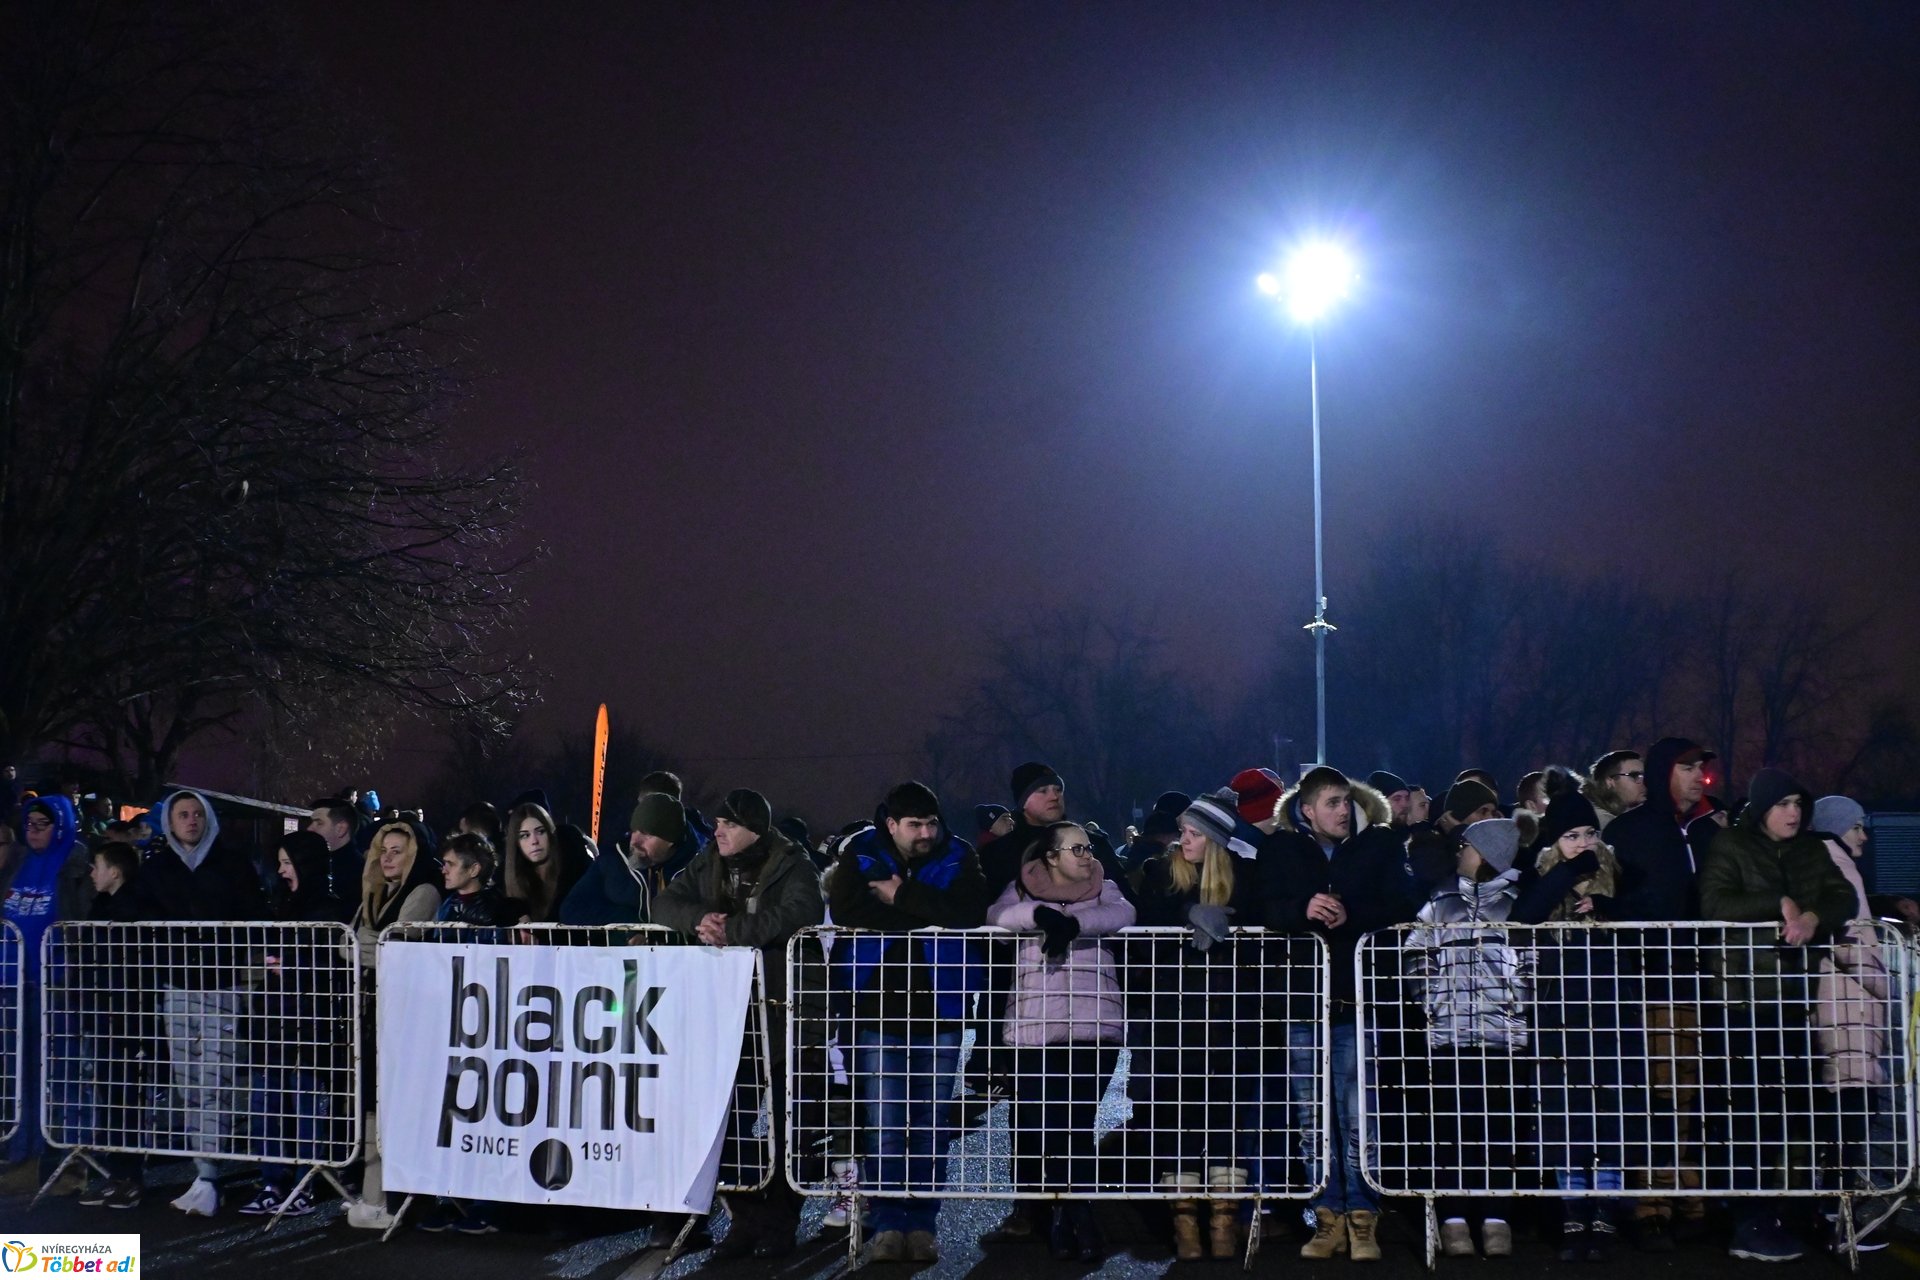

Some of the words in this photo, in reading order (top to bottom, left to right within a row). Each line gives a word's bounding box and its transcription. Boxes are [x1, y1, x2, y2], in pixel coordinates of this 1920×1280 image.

[448, 956, 668, 1055] black
[436, 1055, 659, 1147] point
[460, 1134, 519, 1157] SINCE
[581, 1141, 622, 1162] 1991
